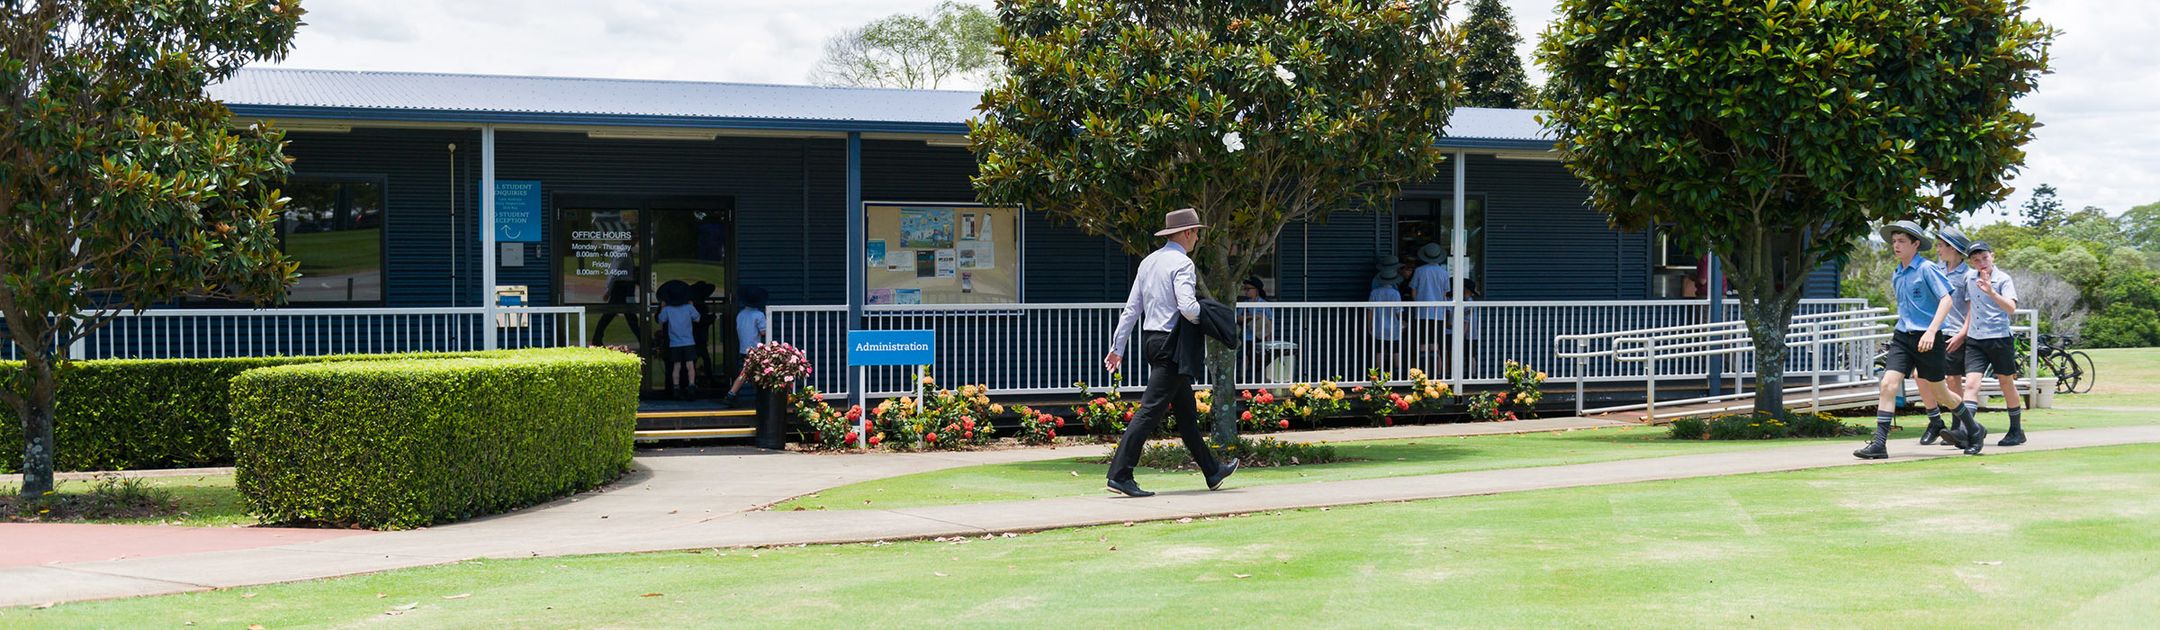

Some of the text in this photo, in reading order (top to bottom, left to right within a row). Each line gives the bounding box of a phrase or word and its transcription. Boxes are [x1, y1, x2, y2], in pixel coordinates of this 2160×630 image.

[571, 231, 632, 239] OFFICE HOURS
[571, 243, 598, 251] Monday
[602, 243, 632, 251] Thursday
[592, 261, 611, 269] Friday
[855, 341, 929, 352] Administration
